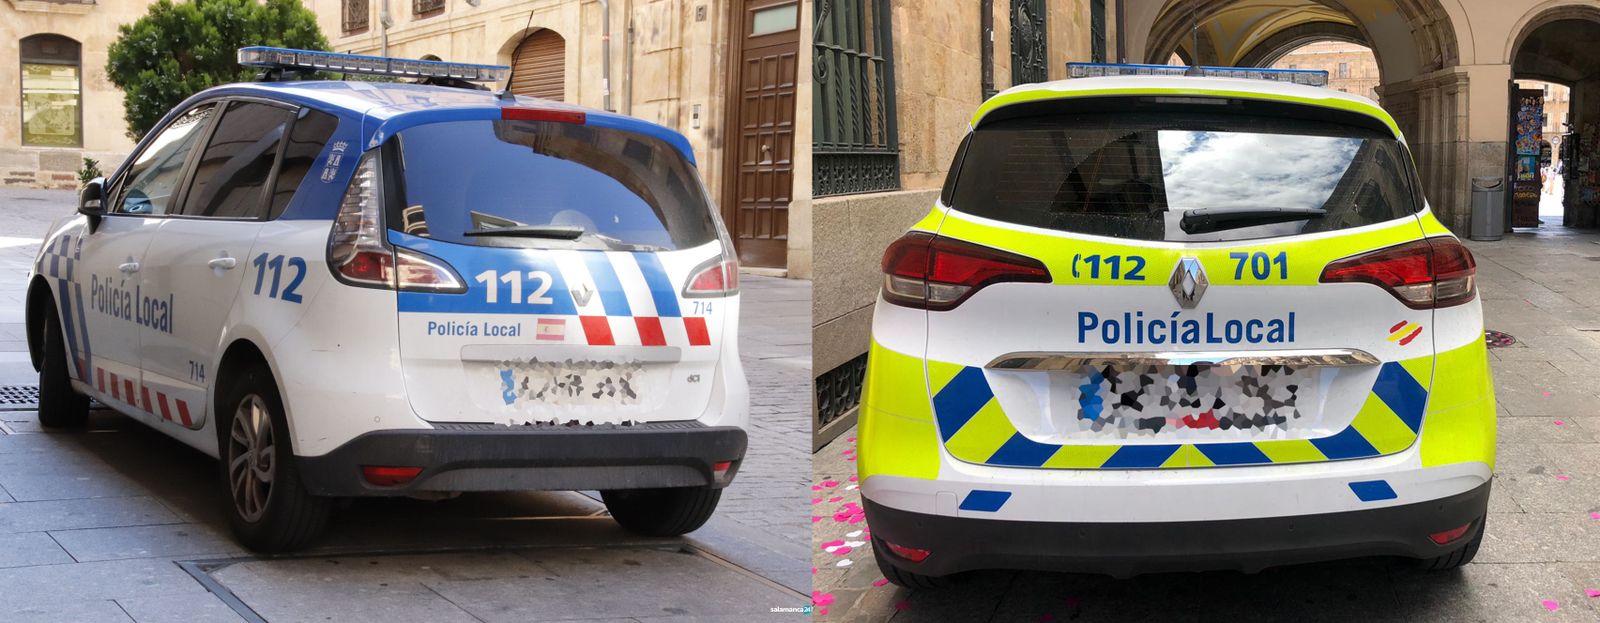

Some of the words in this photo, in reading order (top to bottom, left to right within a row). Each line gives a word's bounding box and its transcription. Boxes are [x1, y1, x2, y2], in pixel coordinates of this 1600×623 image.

[253, 252, 307, 304] 112
[1083, 254, 1146, 280] 112
[1229, 251, 1288, 280] 701
[475, 269, 553, 305] 112
[91, 274, 131, 321] Policía
[136, 285, 174, 334] Local
[692, 301, 713, 315] 714
[427, 320, 479, 337] Policía
[483, 321, 521, 337] Local
[189, 360, 205, 382] 714
